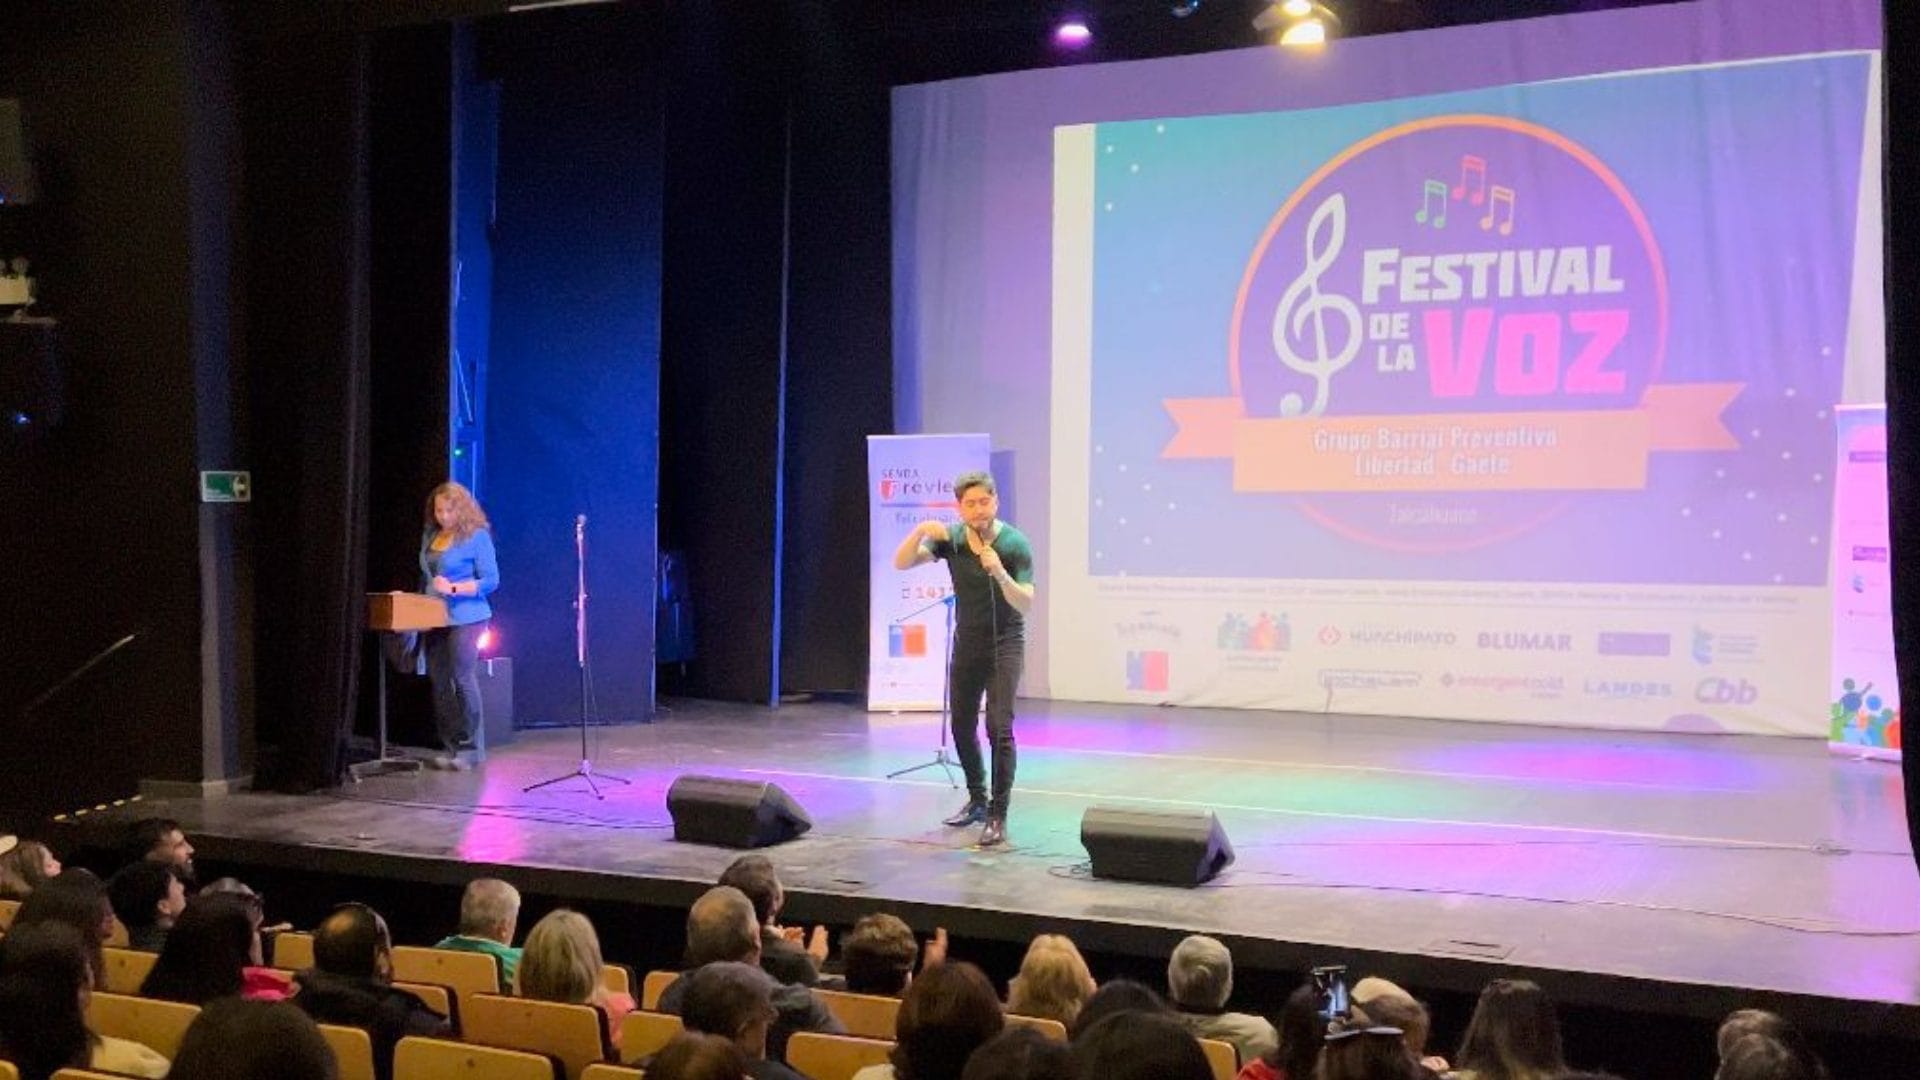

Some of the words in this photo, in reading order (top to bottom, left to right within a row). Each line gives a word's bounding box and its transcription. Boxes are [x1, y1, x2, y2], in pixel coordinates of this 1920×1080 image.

[1362, 245, 1625, 304] FESTIVAL
[1369, 312, 1409, 340] DE
[1377, 344, 1416, 372] LA
[1422, 308, 1630, 398] VOZ
[1313, 429, 1371, 455] Grupo
[1377, 427, 1444, 449] Barrial
[1450, 425, 1558, 448] Preventivo
[881, 468, 919, 479] SENDA
[1354, 453, 1434, 476] Libertad
[1450, 453, 1511, 475] Gaete
[1477, 632, 1572, 652] BLUMAR
[1583, 679, 1672, 697] LANDES
[1694, 677, 1758, 705] Cbb
